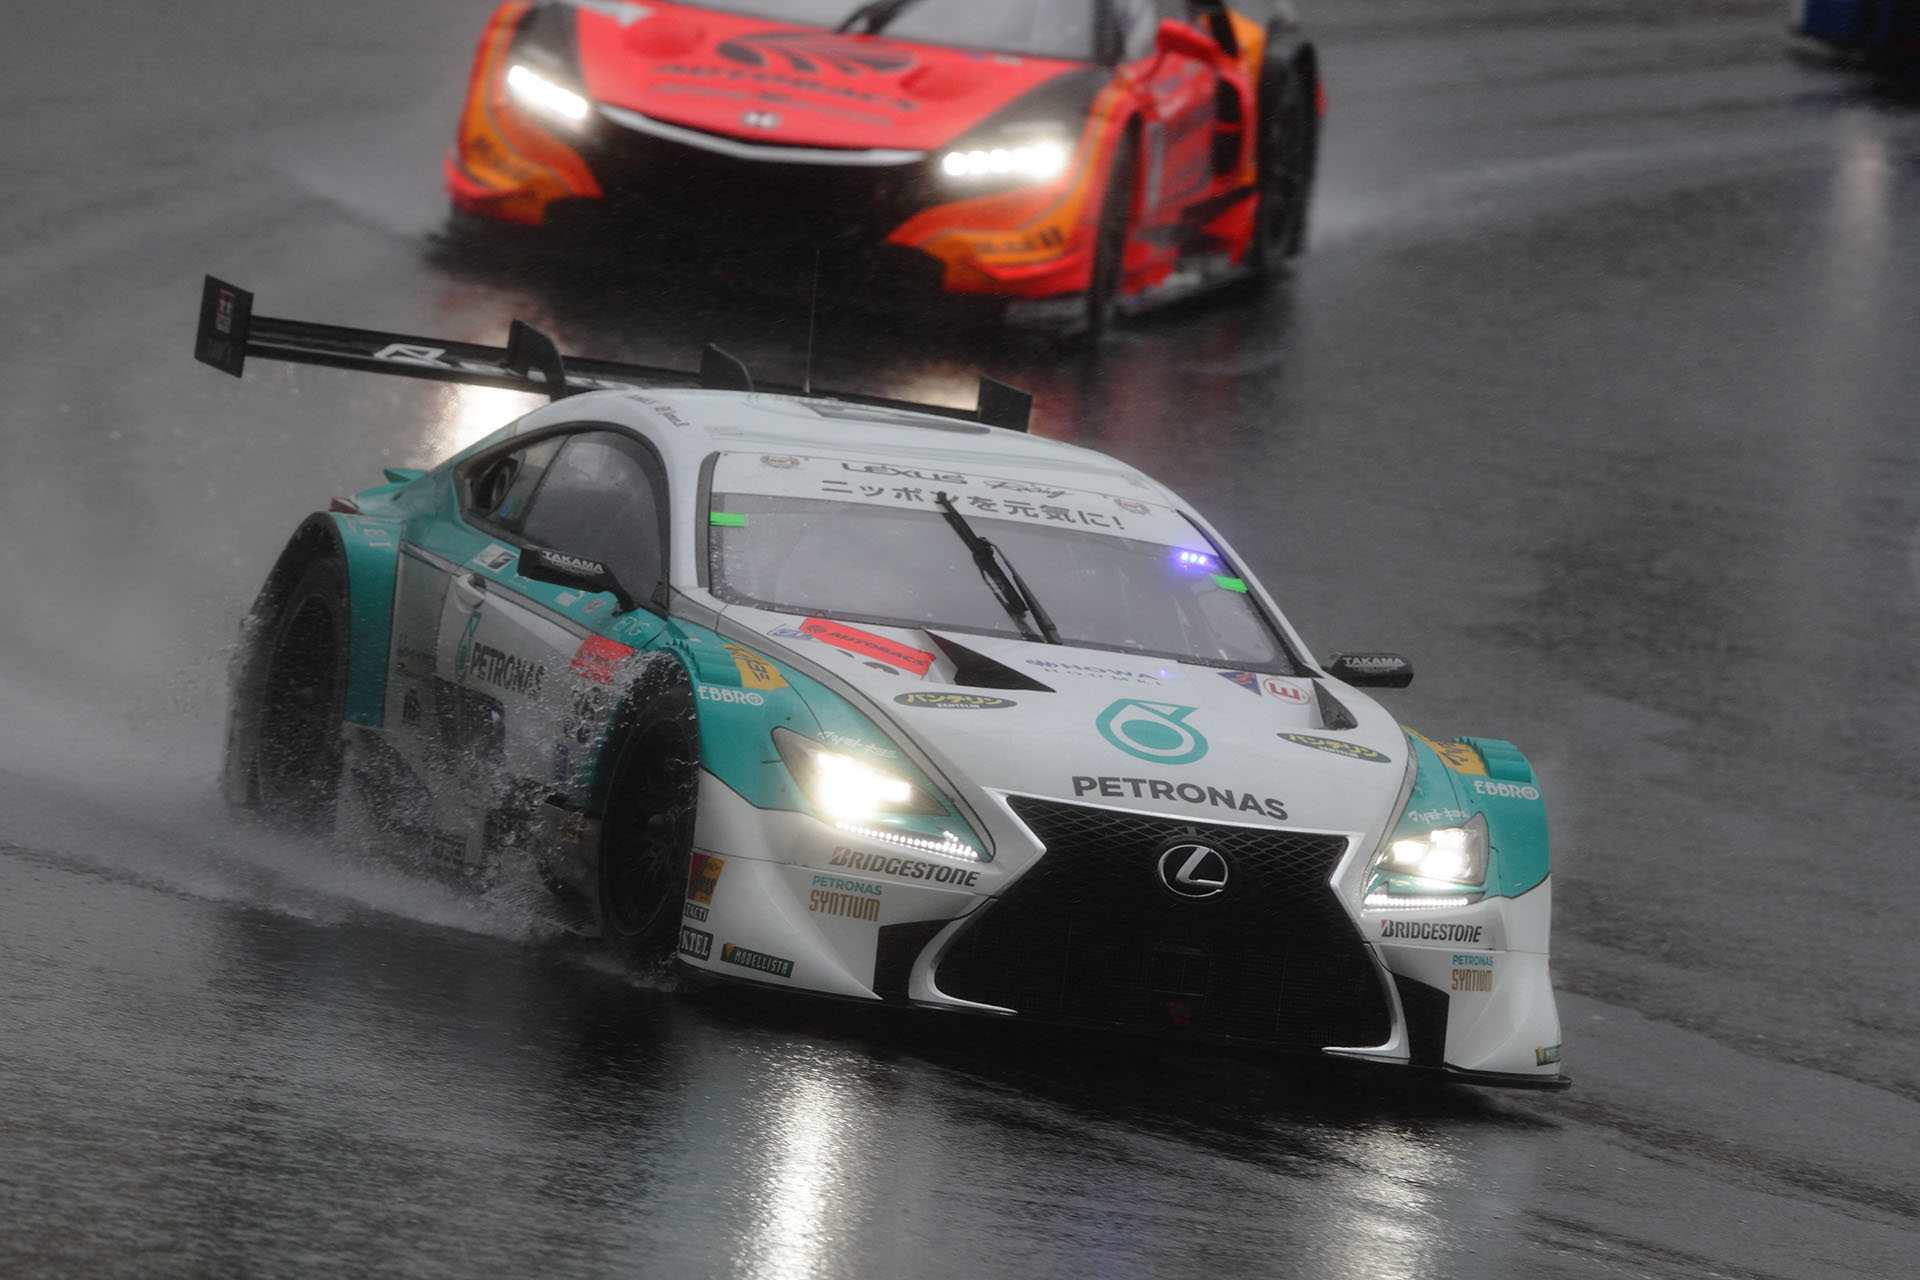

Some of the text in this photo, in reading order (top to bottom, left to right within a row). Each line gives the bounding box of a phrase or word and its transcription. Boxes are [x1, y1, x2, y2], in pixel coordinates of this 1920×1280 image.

[841, 462, 968, 485] LEXUS
[827, 631, 925, 667] AUTOBACS
[698, 685, 765, 707] EBBRO
[1072, 776, 1289, 821] PETRONAS
[1474, 780, 1539, 800] EBBRO
[828, 846, 981, 888] BRIDGESTONE
[812, 875, 883, 896] PETRONAS
[808, 889, 881, 923] SYNTIUM
[1381, 919, 1483, 943] BRIDGESTONE
[734, 949, 790, 975] MODELLISTA
[1453, 954, 1494, 967] PETRONAS
[1452, 968, 1493, 992] SYNTIUM
